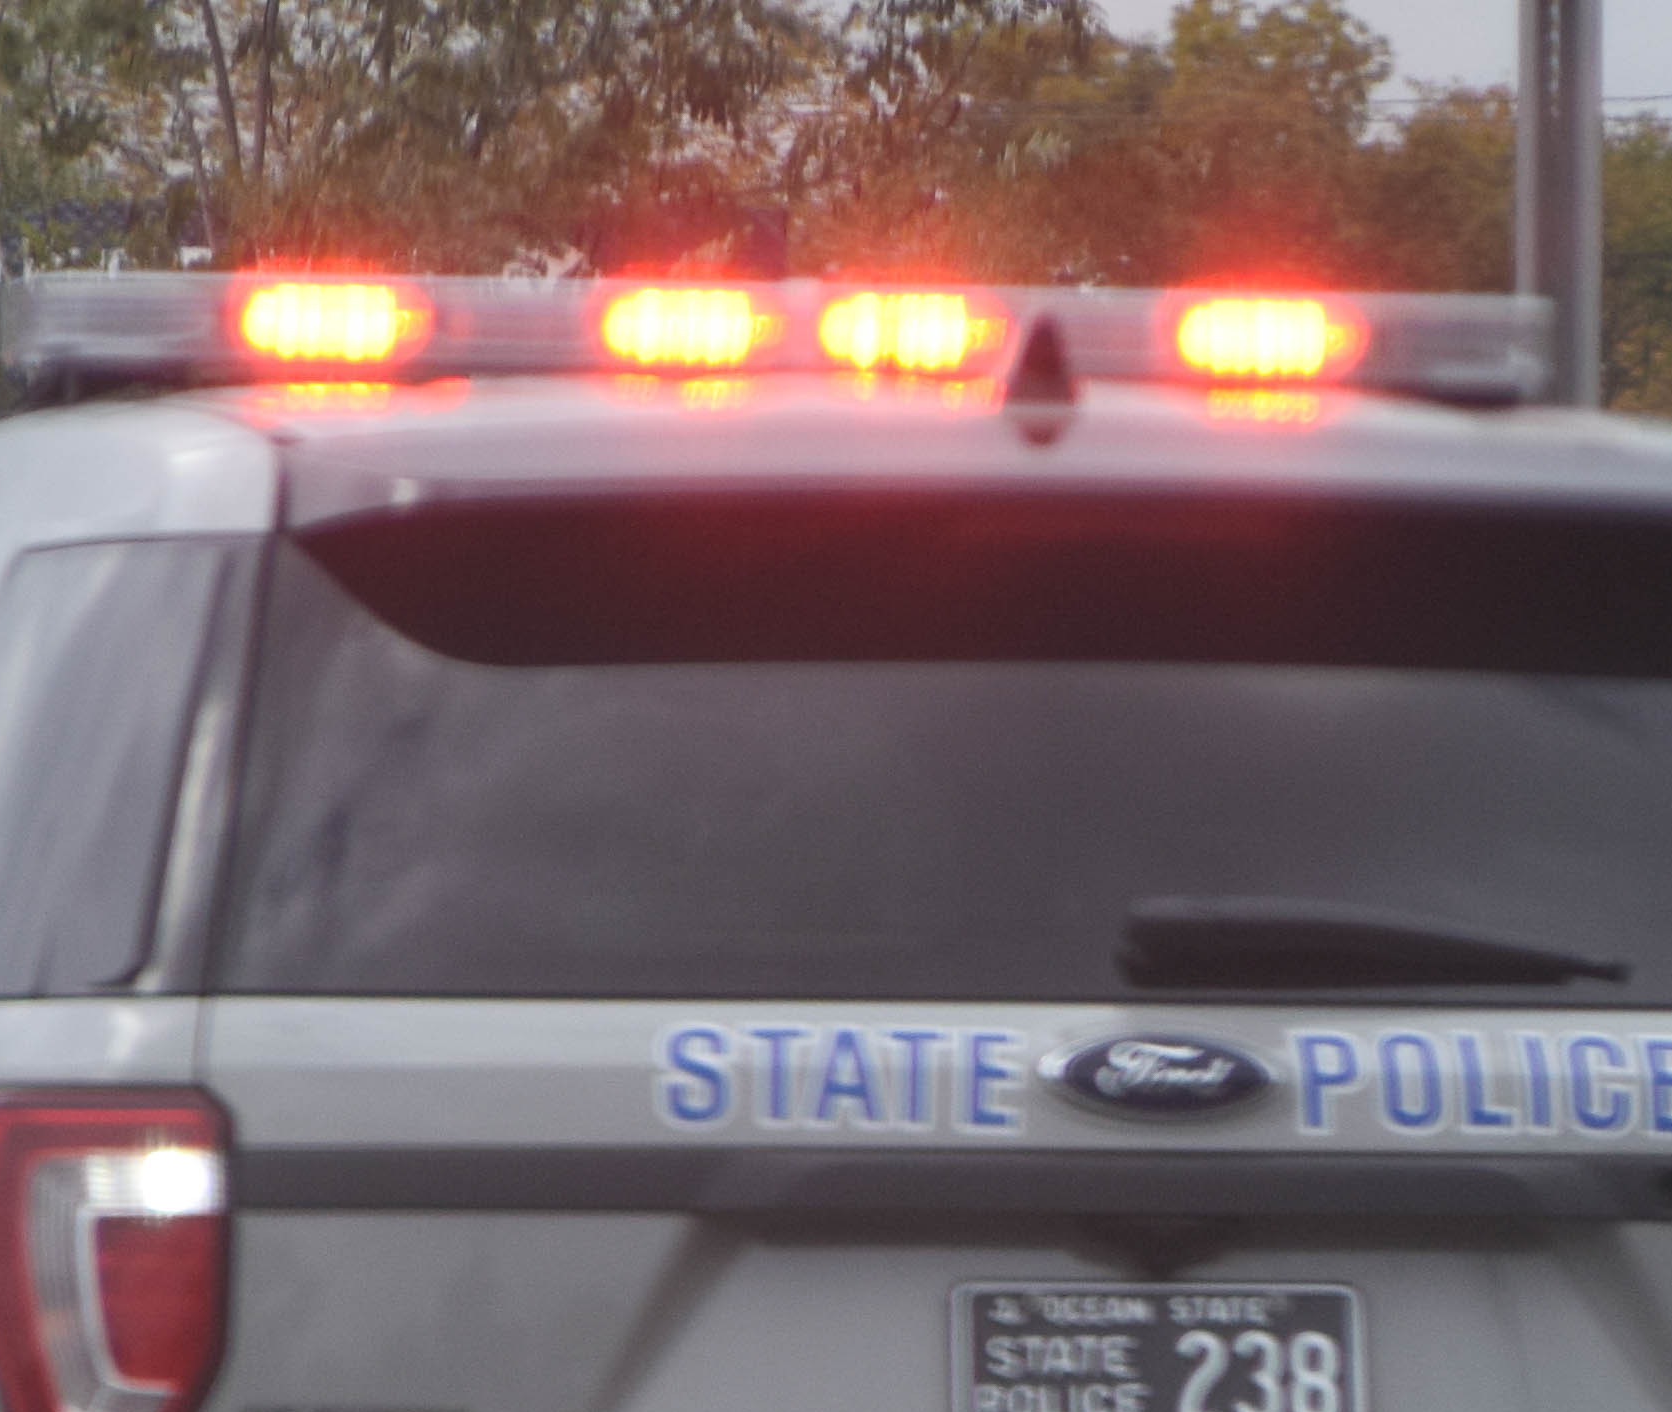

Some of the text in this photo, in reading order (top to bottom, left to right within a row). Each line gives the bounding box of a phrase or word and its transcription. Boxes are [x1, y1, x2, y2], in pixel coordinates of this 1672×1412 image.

[657, 1022, 1021, 1134] STATE
[1094, 1039, 1235, 1099] Ford
[985, 1334, 1143, 1380] STATE
